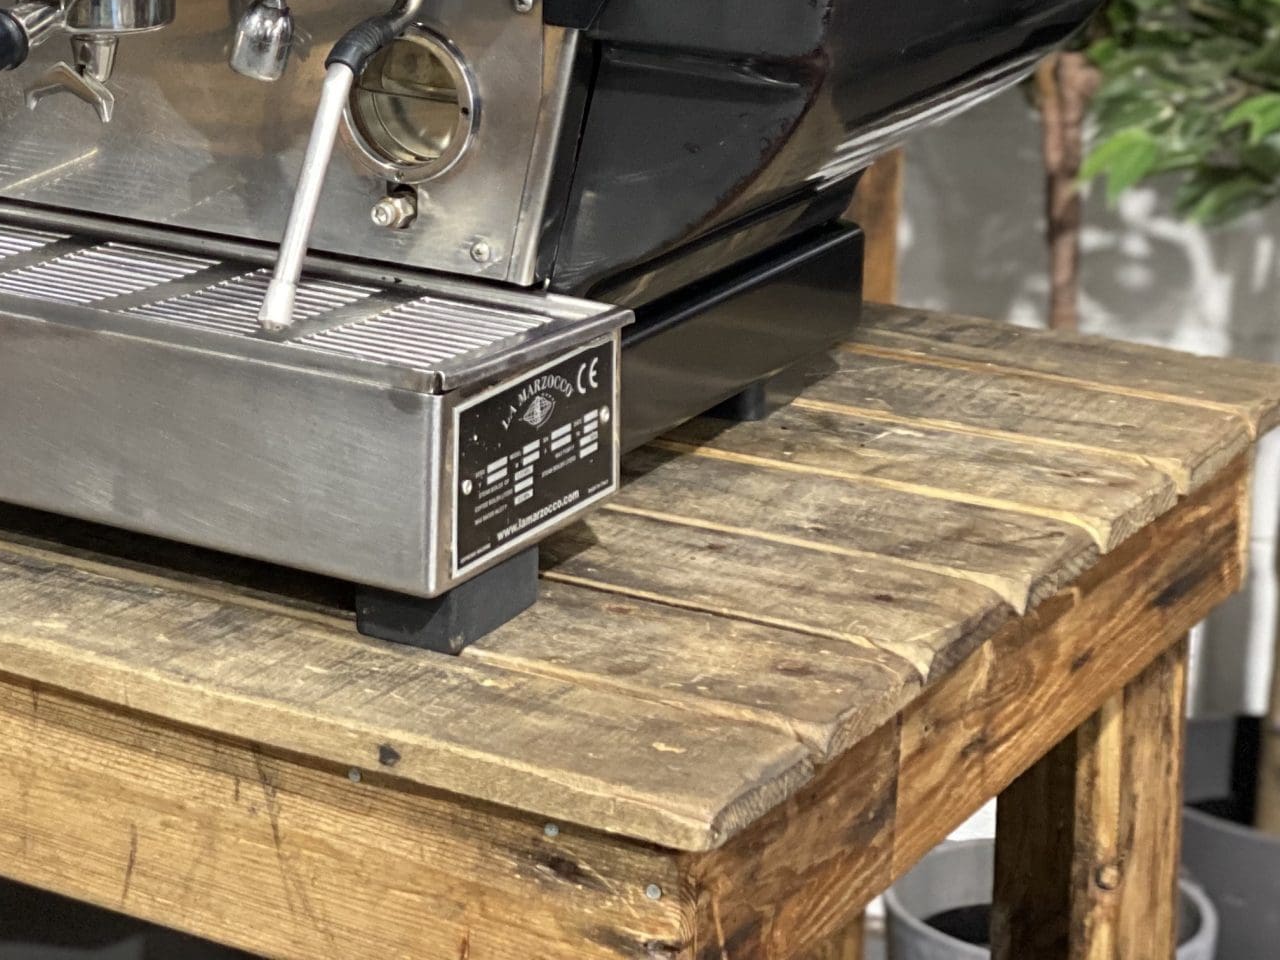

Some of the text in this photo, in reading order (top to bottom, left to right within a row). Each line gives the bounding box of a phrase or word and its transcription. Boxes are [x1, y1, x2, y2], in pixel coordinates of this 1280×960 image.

[576, 356, 599, 395] CE
[501, 373, 575, 431] LA MARZOCCO
[496, 489, 581, 541] www.lamarzocco.com
